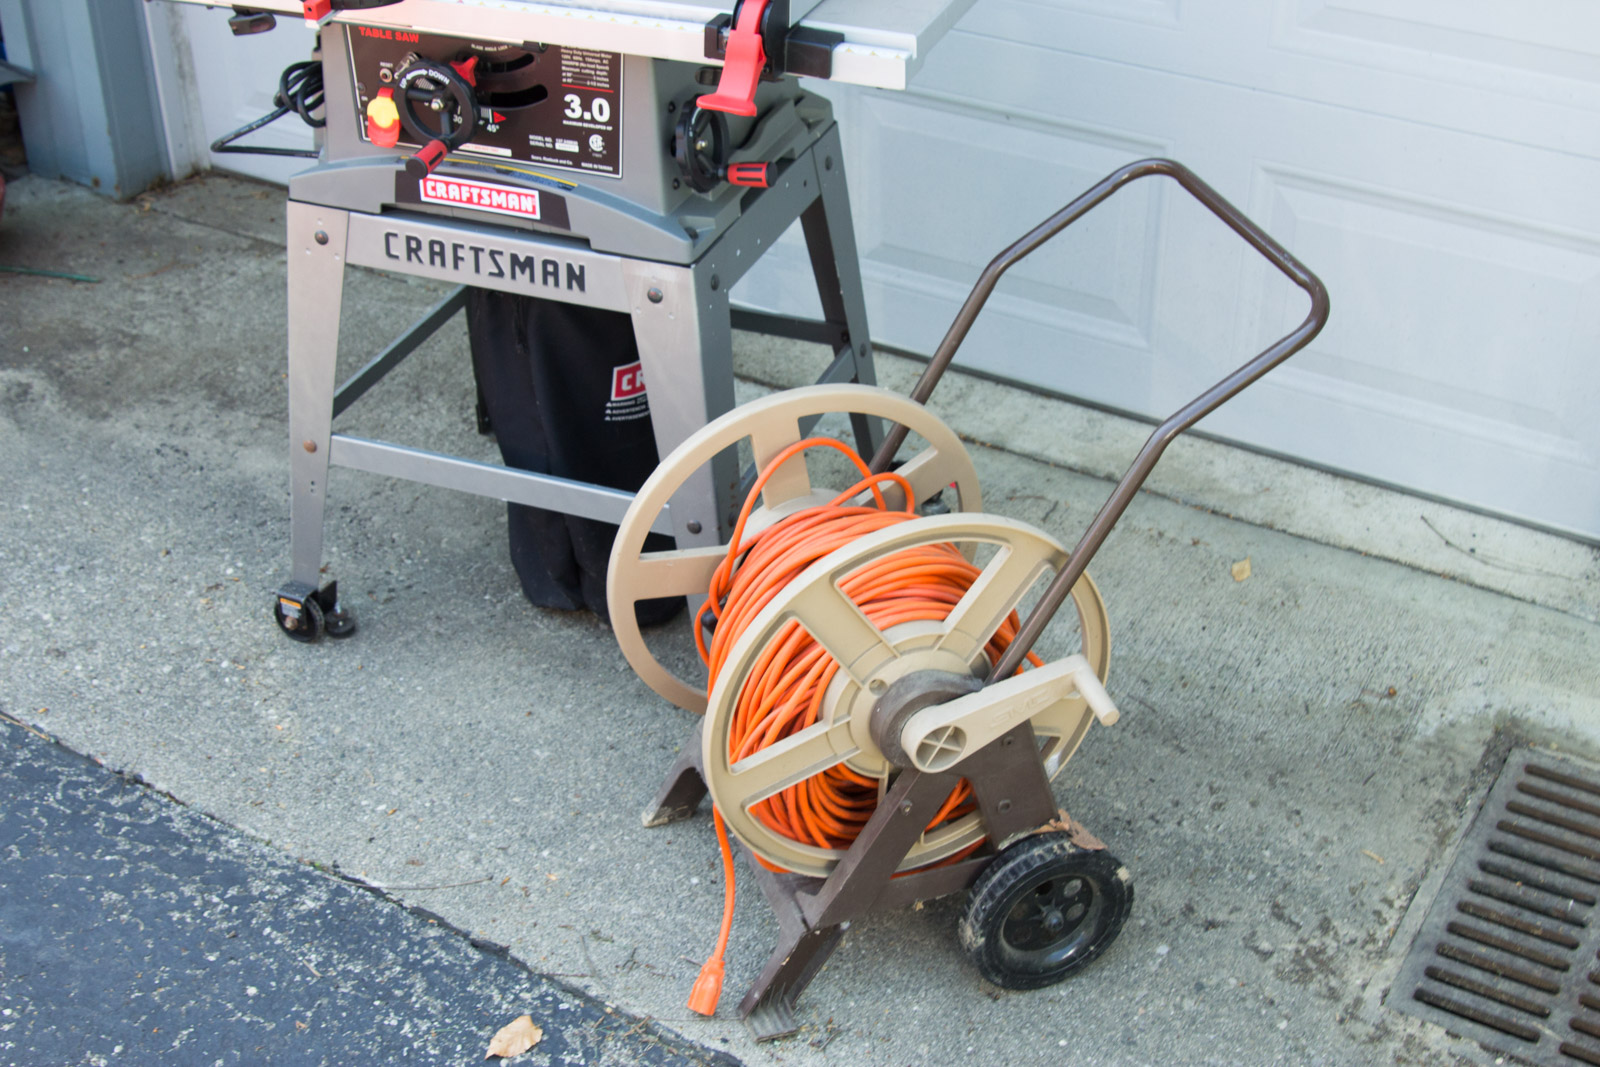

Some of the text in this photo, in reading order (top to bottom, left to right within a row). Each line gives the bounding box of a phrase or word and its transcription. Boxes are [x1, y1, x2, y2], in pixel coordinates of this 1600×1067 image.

[358, 26, 419, 43] TABLE SAW
[399, 77, 408, 89] UP
[428, 68, 450, 85] DOWN
[564, 93, 610, 123] 3.0
[453, 114, 463, 124] 30
[528, 134, 544, 142] MODEL
[529, 140, 545, 148] SERIAL
[425, 179, 533, 213] CRAFTSMAN
[384, 231, 586, 293] CRAFTSMAN
